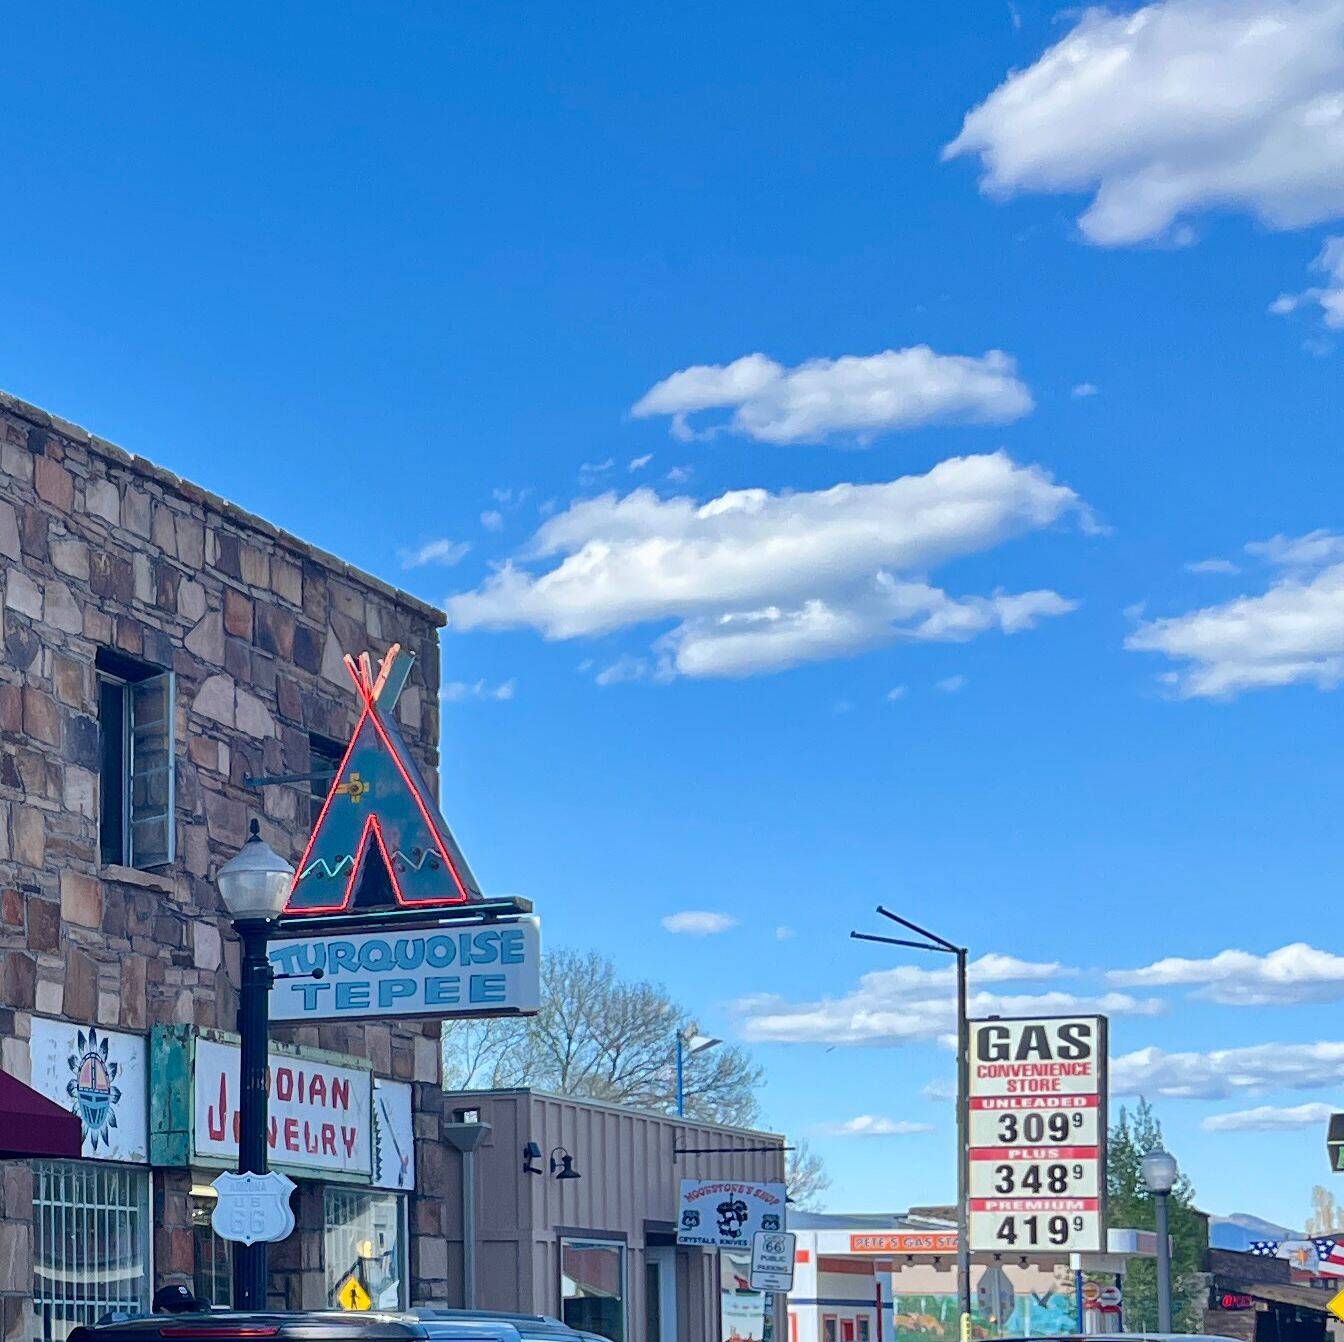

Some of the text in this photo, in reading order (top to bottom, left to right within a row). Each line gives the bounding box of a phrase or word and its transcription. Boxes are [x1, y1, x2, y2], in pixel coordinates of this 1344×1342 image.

[269, 929, 525, 975] TURQUOISE
[291, 973, 507, 1011] TEPEE
[976, 1023, 1091, 1062] GAS
[976, 1061, 1092, 1079] CONVENIENCE
[265, 1064, 349, 1111] DIAN
[1006, 1078, 1061, 1093] STORE
[982, 1097, 1087, 1109] UNLEADED
[1008, 1148, 1060, 1160] PLUS
[985, 1200, 1085, 1211] PREMIUM
[765, 1241, 781, 1252] 66
[854, 1237, 898, 1248] PETE'S
[903, 1237, 932, 1248] GAS
